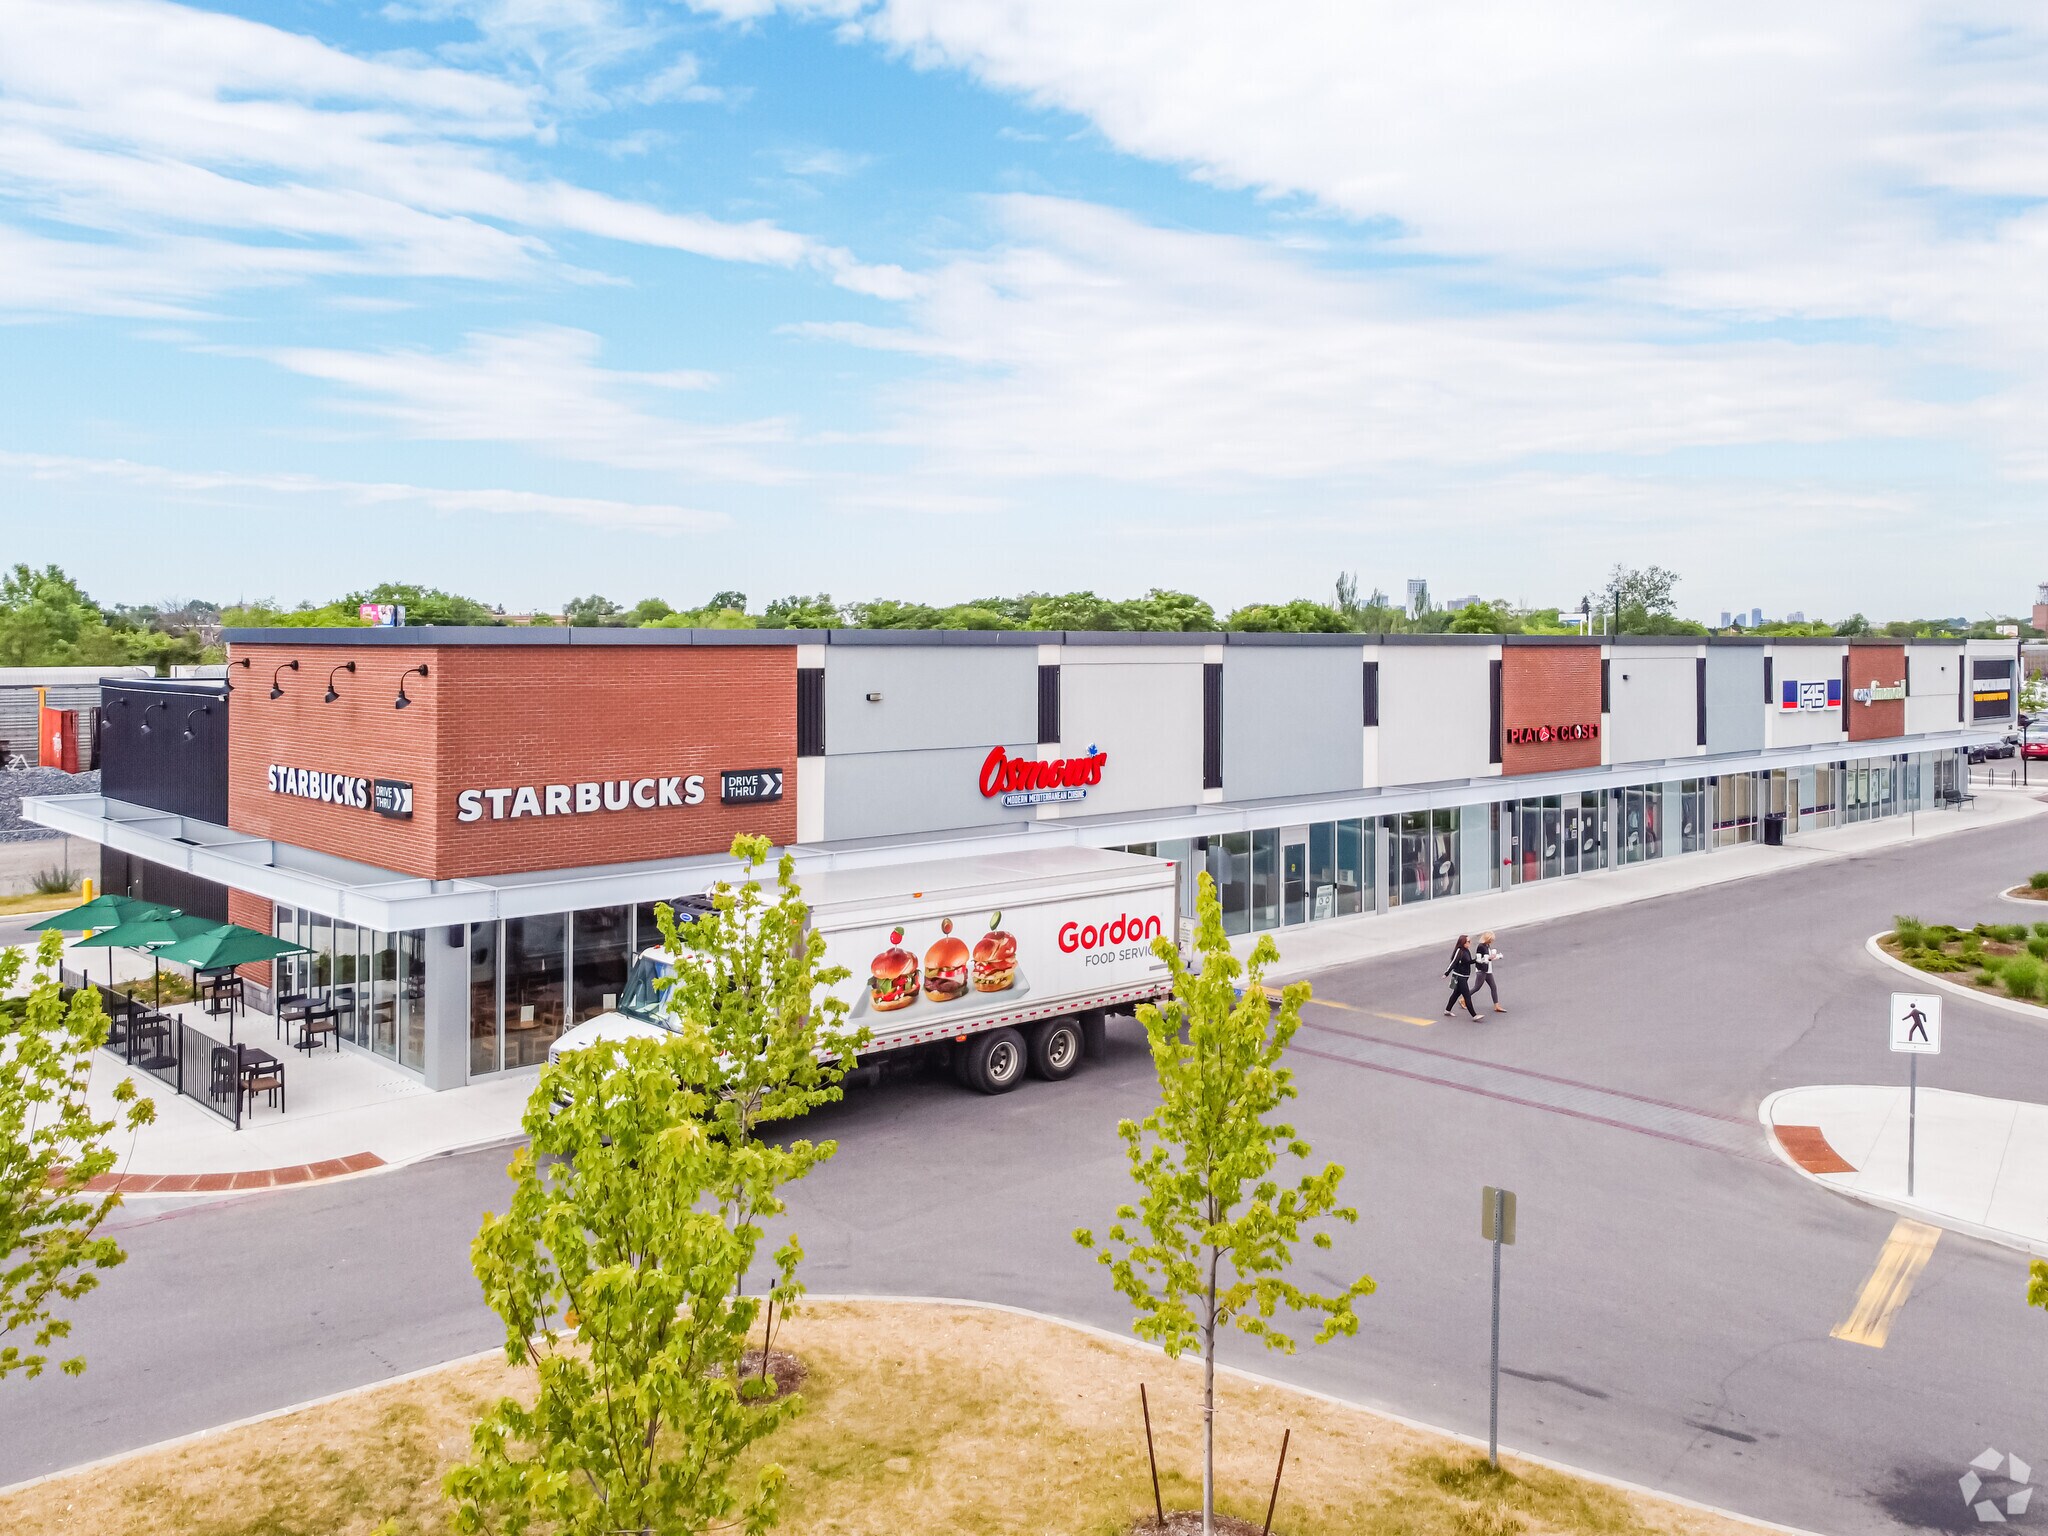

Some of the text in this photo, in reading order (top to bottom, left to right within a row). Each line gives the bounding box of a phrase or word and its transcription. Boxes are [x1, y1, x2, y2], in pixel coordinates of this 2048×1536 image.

[1800, 682, 1826, 709] F45
[1561, 724, 1600, 741] CLOSET
[268, 764, 368, 809] STARBUCKS
[728, 775, 759, 787] DRIVE
[375, 785, 393, 798] DRIVE
[458, 775, 706, 822] STARBUCKS
[728, 785, 757, 798] THRU
[375, 796, 392, 809] THRU
[1058, 913, 1161, 954] Gordon
[1085, 945, 1154, 967] FOOD SERVIC
